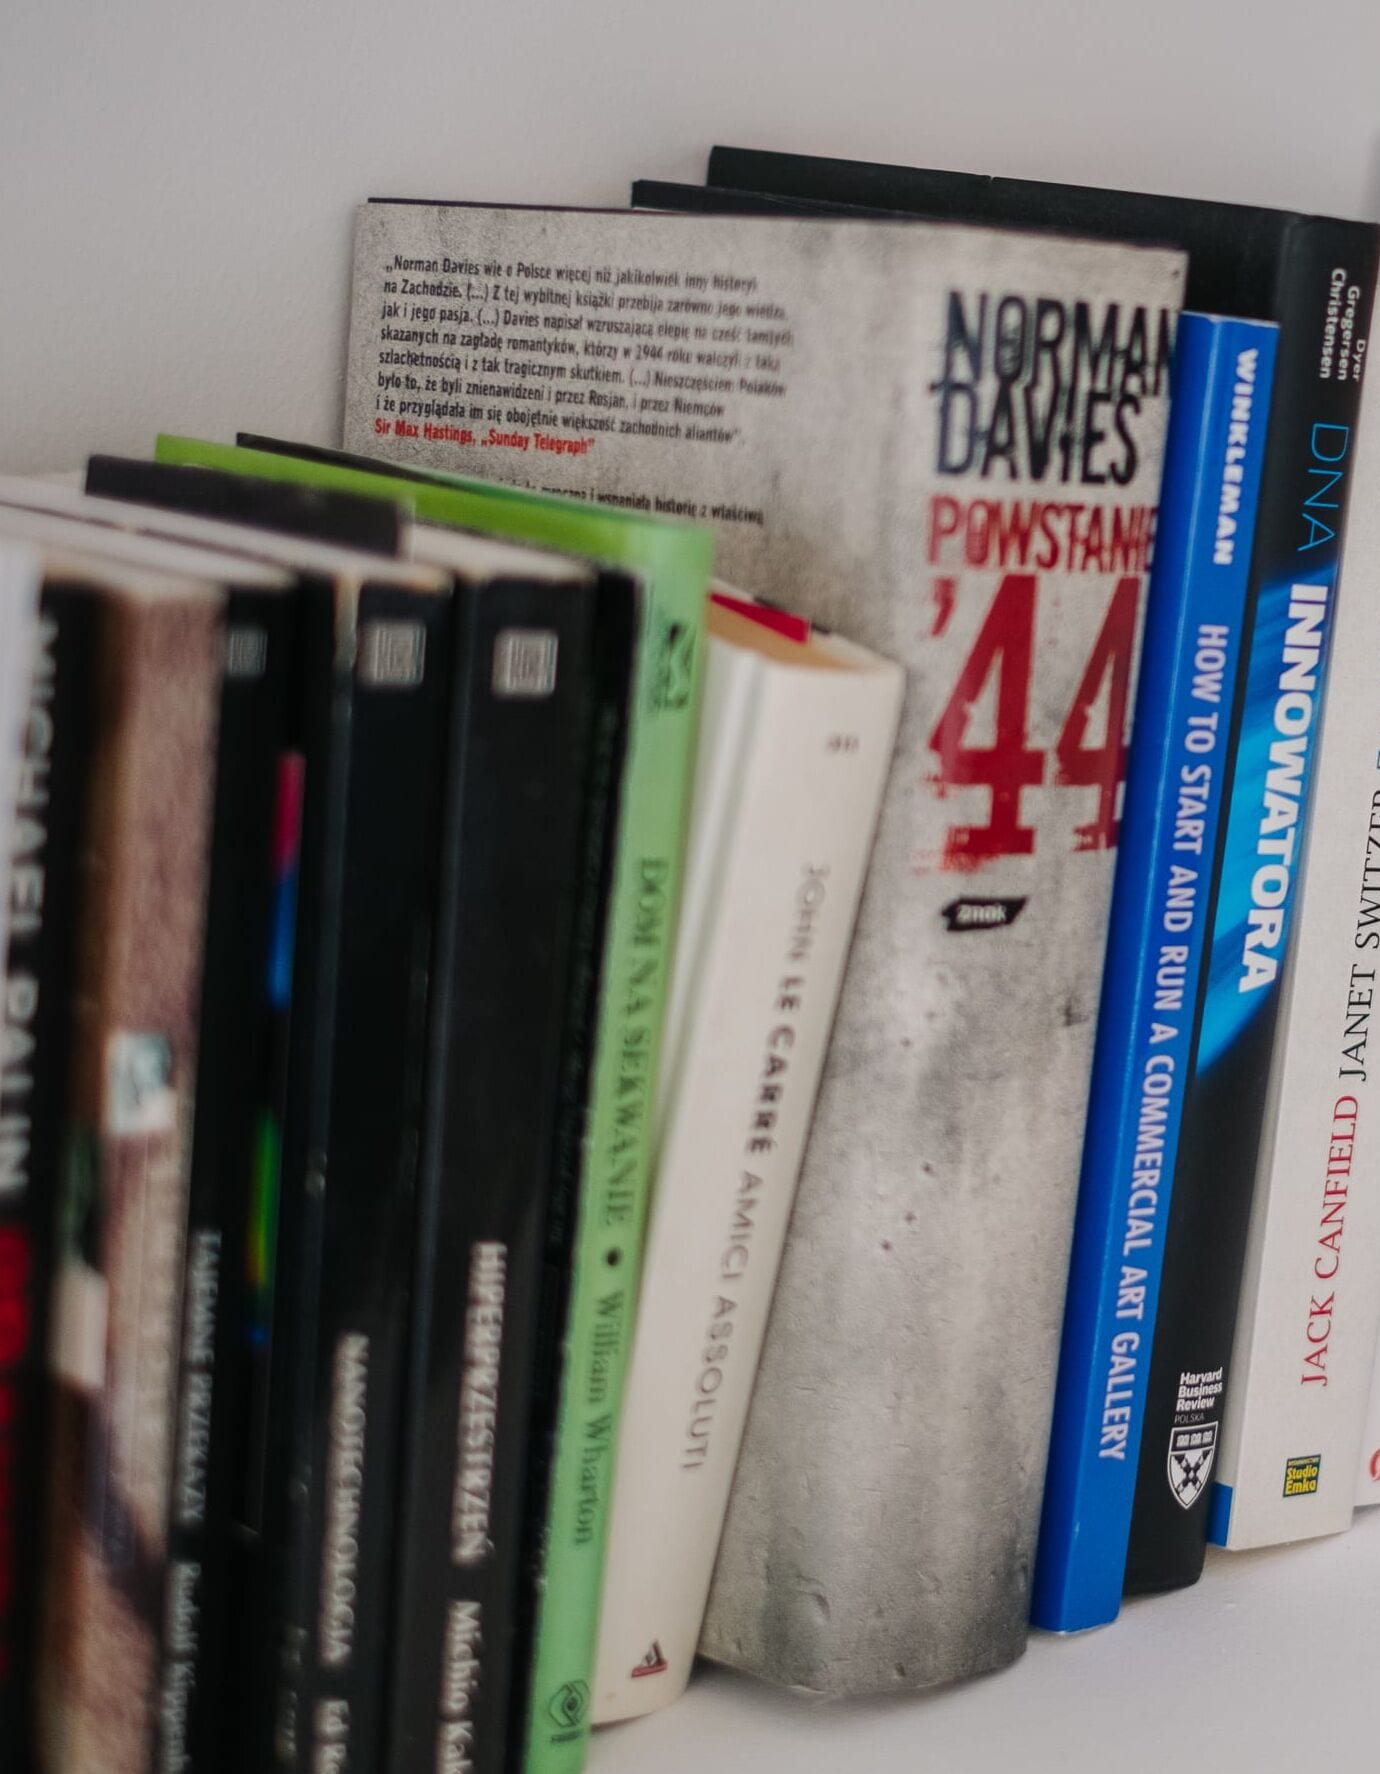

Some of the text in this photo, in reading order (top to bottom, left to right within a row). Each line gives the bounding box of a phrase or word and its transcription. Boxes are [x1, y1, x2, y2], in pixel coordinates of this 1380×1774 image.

[384, 280, 398, 294] na
[493, 284, 501, 300] Z
[504, 285, 519, 306] tej
[524, 286, 571, 308] wybitnej
[576, 288, 614, 311] książki
[618, 294, 664, 315] przebija
[442, 258, 480, 276] Davies
[484, 260, 502, 277] wie
[517, 262, 551, 280] Polsce
[556, 265, 592, 285] więcej
[685, 272, 709, 293] inny
[381, 300, 400, 320] jak
[410, 302, 436, 323] jego
[504, 309, 540, 328] Davies
[544, 311, 583, 331] napisał
[694, 326, 709, 339] na
[381, 325, 439, 347] skazanych
[443, 332, 457, 347] na
[460, 331, 503, 353] zagładę
[584, 340, 618, 362] którzy
[623, 346, 632, 359] w
[1318, 267, 1347, 379] Christensen
[1337, 284, 1361, 381] Gregersen
[378, 370, 401, 389] było
[425, 378, 437, 393] że
[441, 376, 463, 396] byli
[466, 380, 545, 401] znienawidzeni
[555, 390, 585, 407] przez
[640, 397, 670, 414] przez
[674, 398, 725, 417] Niemców
[379, 350, 461, 373] szlachetnością
[472, 358, 478, 371] z
[482, 356, 500, 374] tak
[504, 358, 567, 382] tragicznym
[1352, 338, 1367, 383] Dyer
[375, 417, 391, 435] Sir
[395, 418, 418, 437] Max
[383, 395, 681, 438] że przyglądała im się obojętnie większość zachodnich
[930, 378, 1142, 487] DAVIES
[1212, 347, 1260, 566] WINKLEMAN
[1237, 422, 1350, 994] DNA INNOWATORA
[775, 973, 805, 1012] LE
[1338, 963, 1376, 1082] JANET
[1097, 623, 1230, 1463] HOW TO START AND RUN A COMMERCIAL ART GALLERY
[573, 857, 670, 1548] DOM NA SEKWANIE William Wharton
[1314, 1094, 1359, 1280] CANFIELD
[720, 1168, 765, 1283] AMICI
[188, 1227, 222, 1368] TAJEMNE
[1300, 1290, 1336, 1388] JACK
[679, 1293, 739, 1472] ASSOLUTI
[1175, 1396, 1216, 1413] Review
[1178, 1381, 1223, 1399] Business
[1179, 1366, 1224, 1386] Harvard
[175, 1371, 214, 1529] PRZEKAZY
[1173, 1412, 1206, 1425] POLSKA
[437, 1240, 507, 1774] HIPERPRZESTRZEŃ Michio Kak
[1284, 1479, 1317, 1495] Emka
[1287, 1465, 1319, 1481] Studio
[314, 1329, 370, 1743] NANOTECHNOLOGIA Ed
